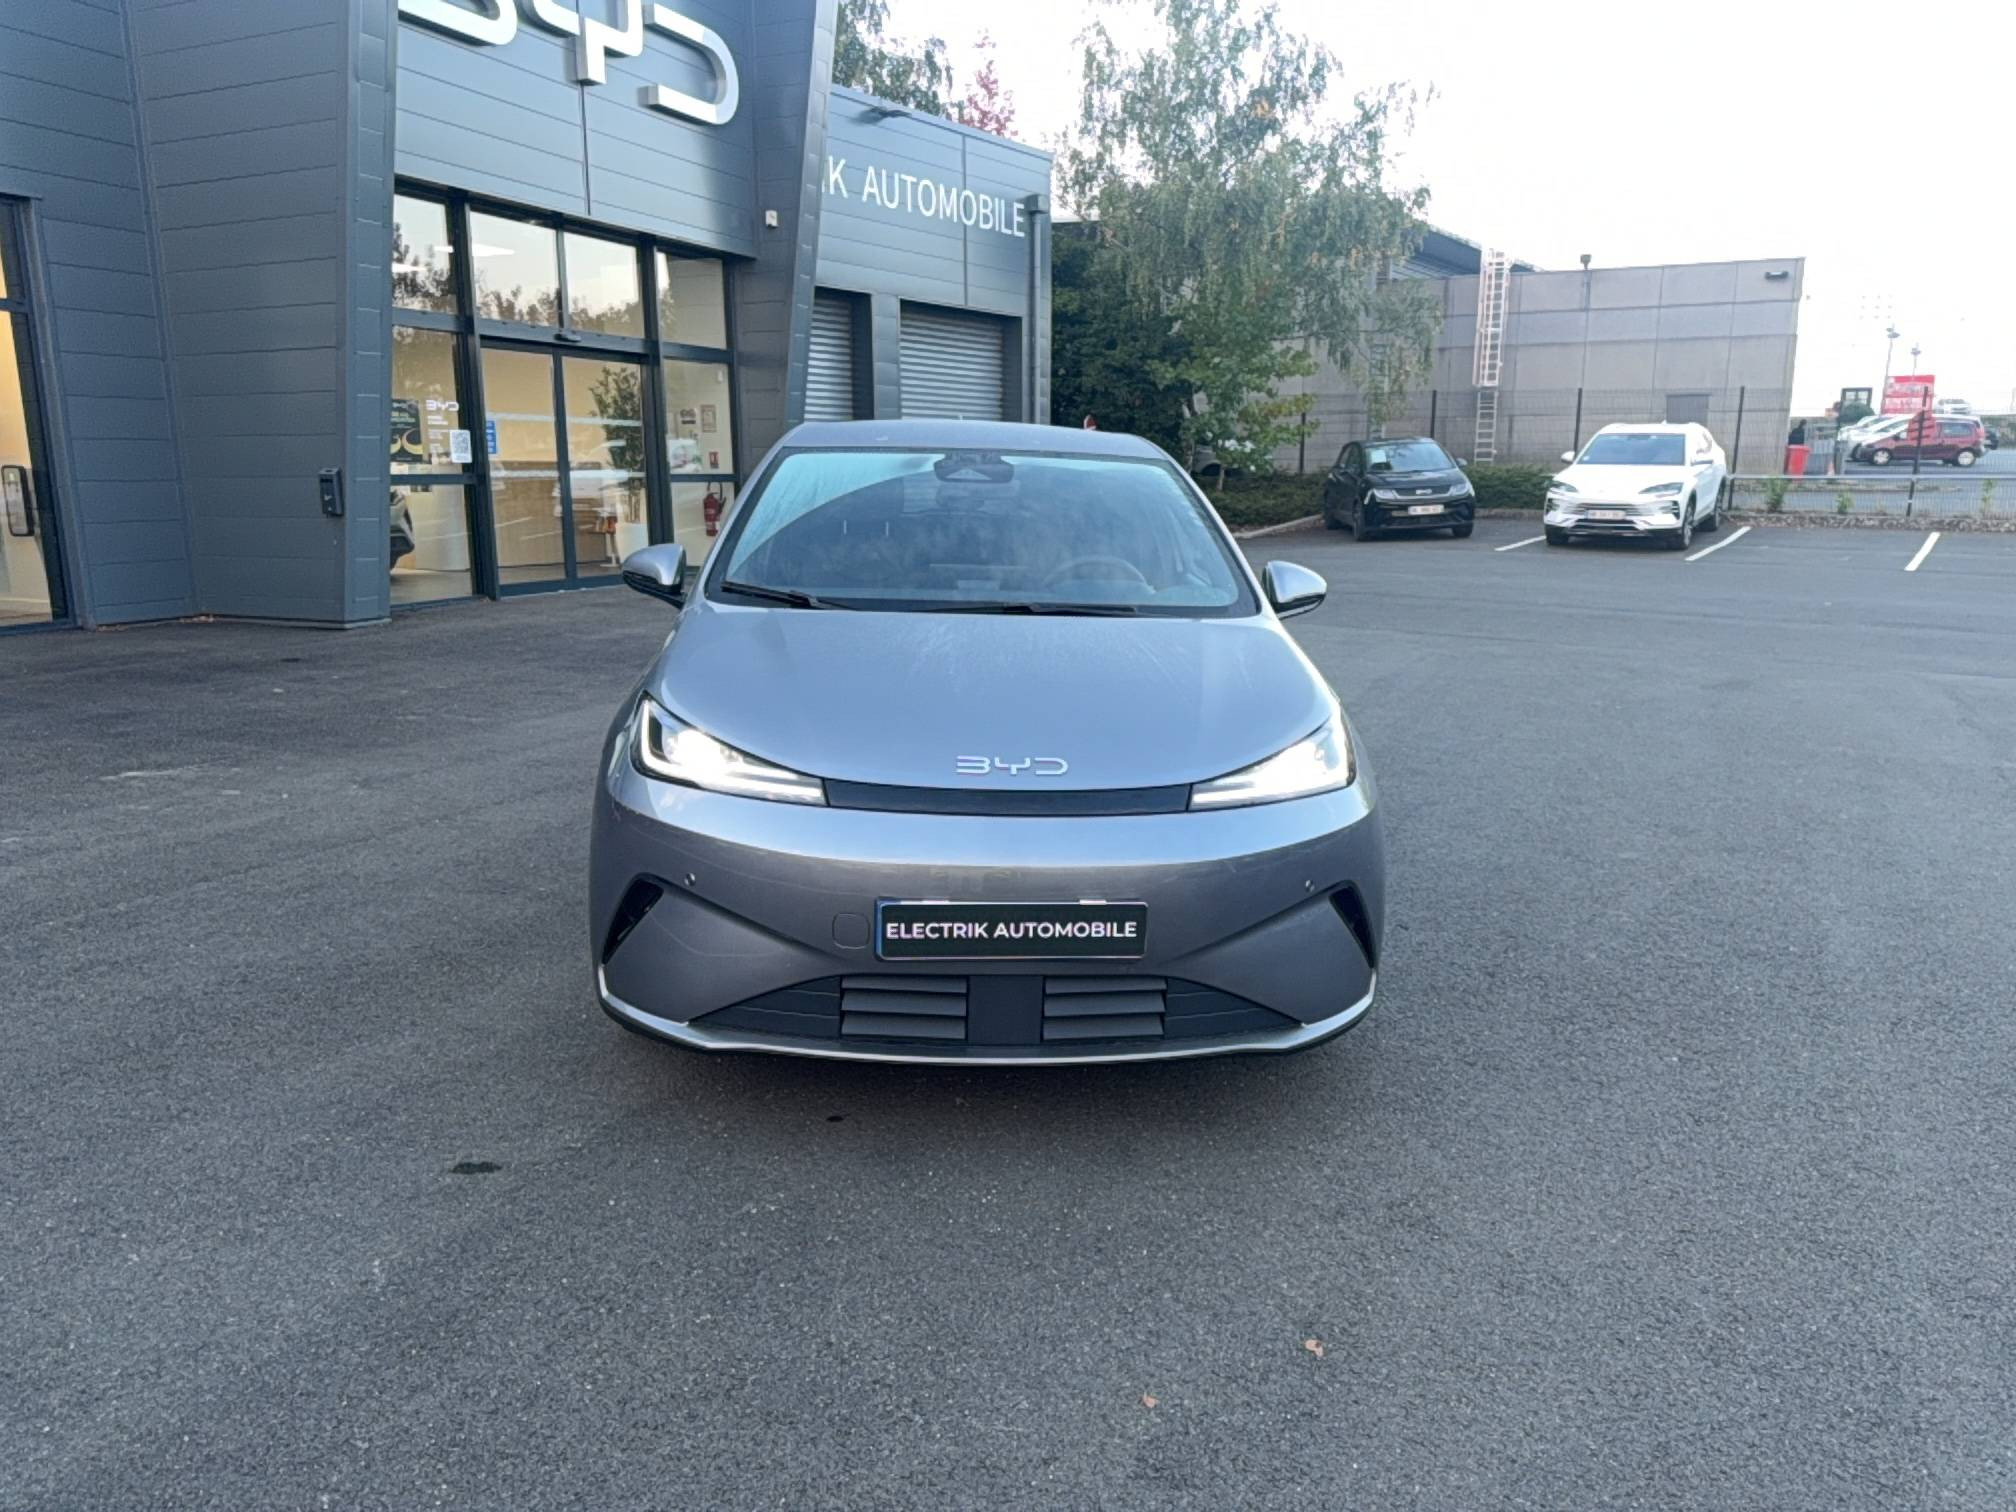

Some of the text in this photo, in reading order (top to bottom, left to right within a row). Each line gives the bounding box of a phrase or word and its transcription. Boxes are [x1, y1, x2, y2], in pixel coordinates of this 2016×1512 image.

[861, 165, 1026, 237] AUTOMOBILE
[956, 755, 1069, 775] BYD
[886, 920, 1138, 940] ELECTRIK AUTOMOBILE
